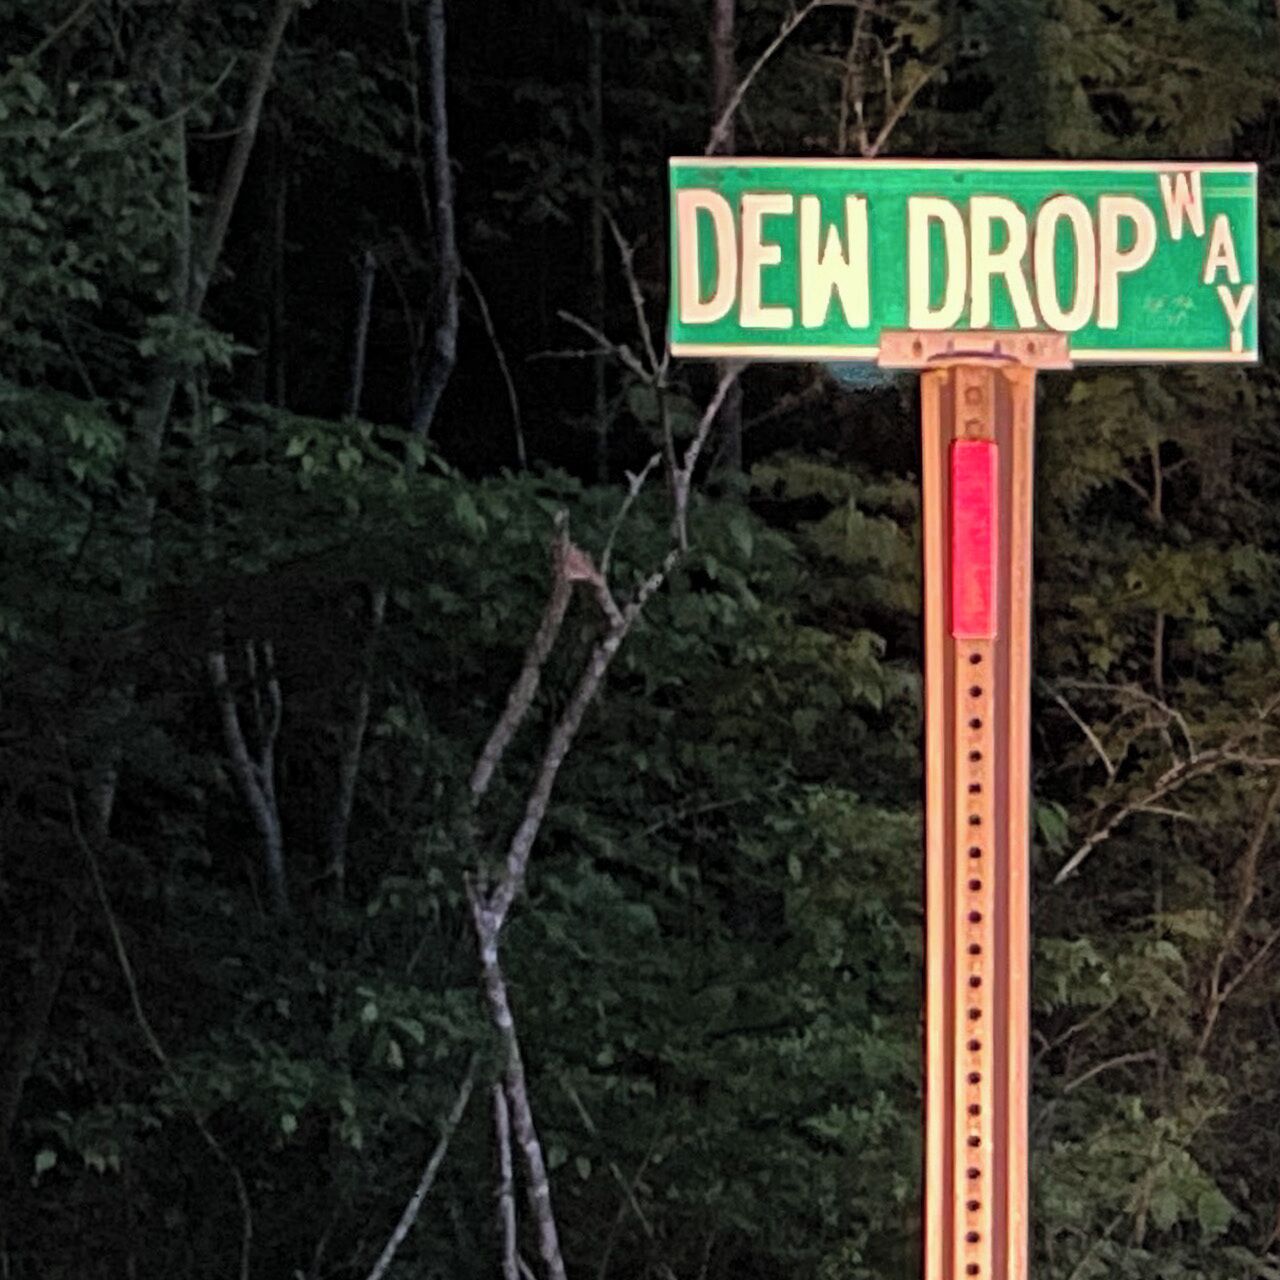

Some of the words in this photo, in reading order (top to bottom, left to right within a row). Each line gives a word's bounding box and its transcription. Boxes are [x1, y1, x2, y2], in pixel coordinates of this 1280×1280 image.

[676, 188, 871, 330] DEW
[907, 192, 1158, 333] DROP
[1159, 170, 1255, 354] WAY
